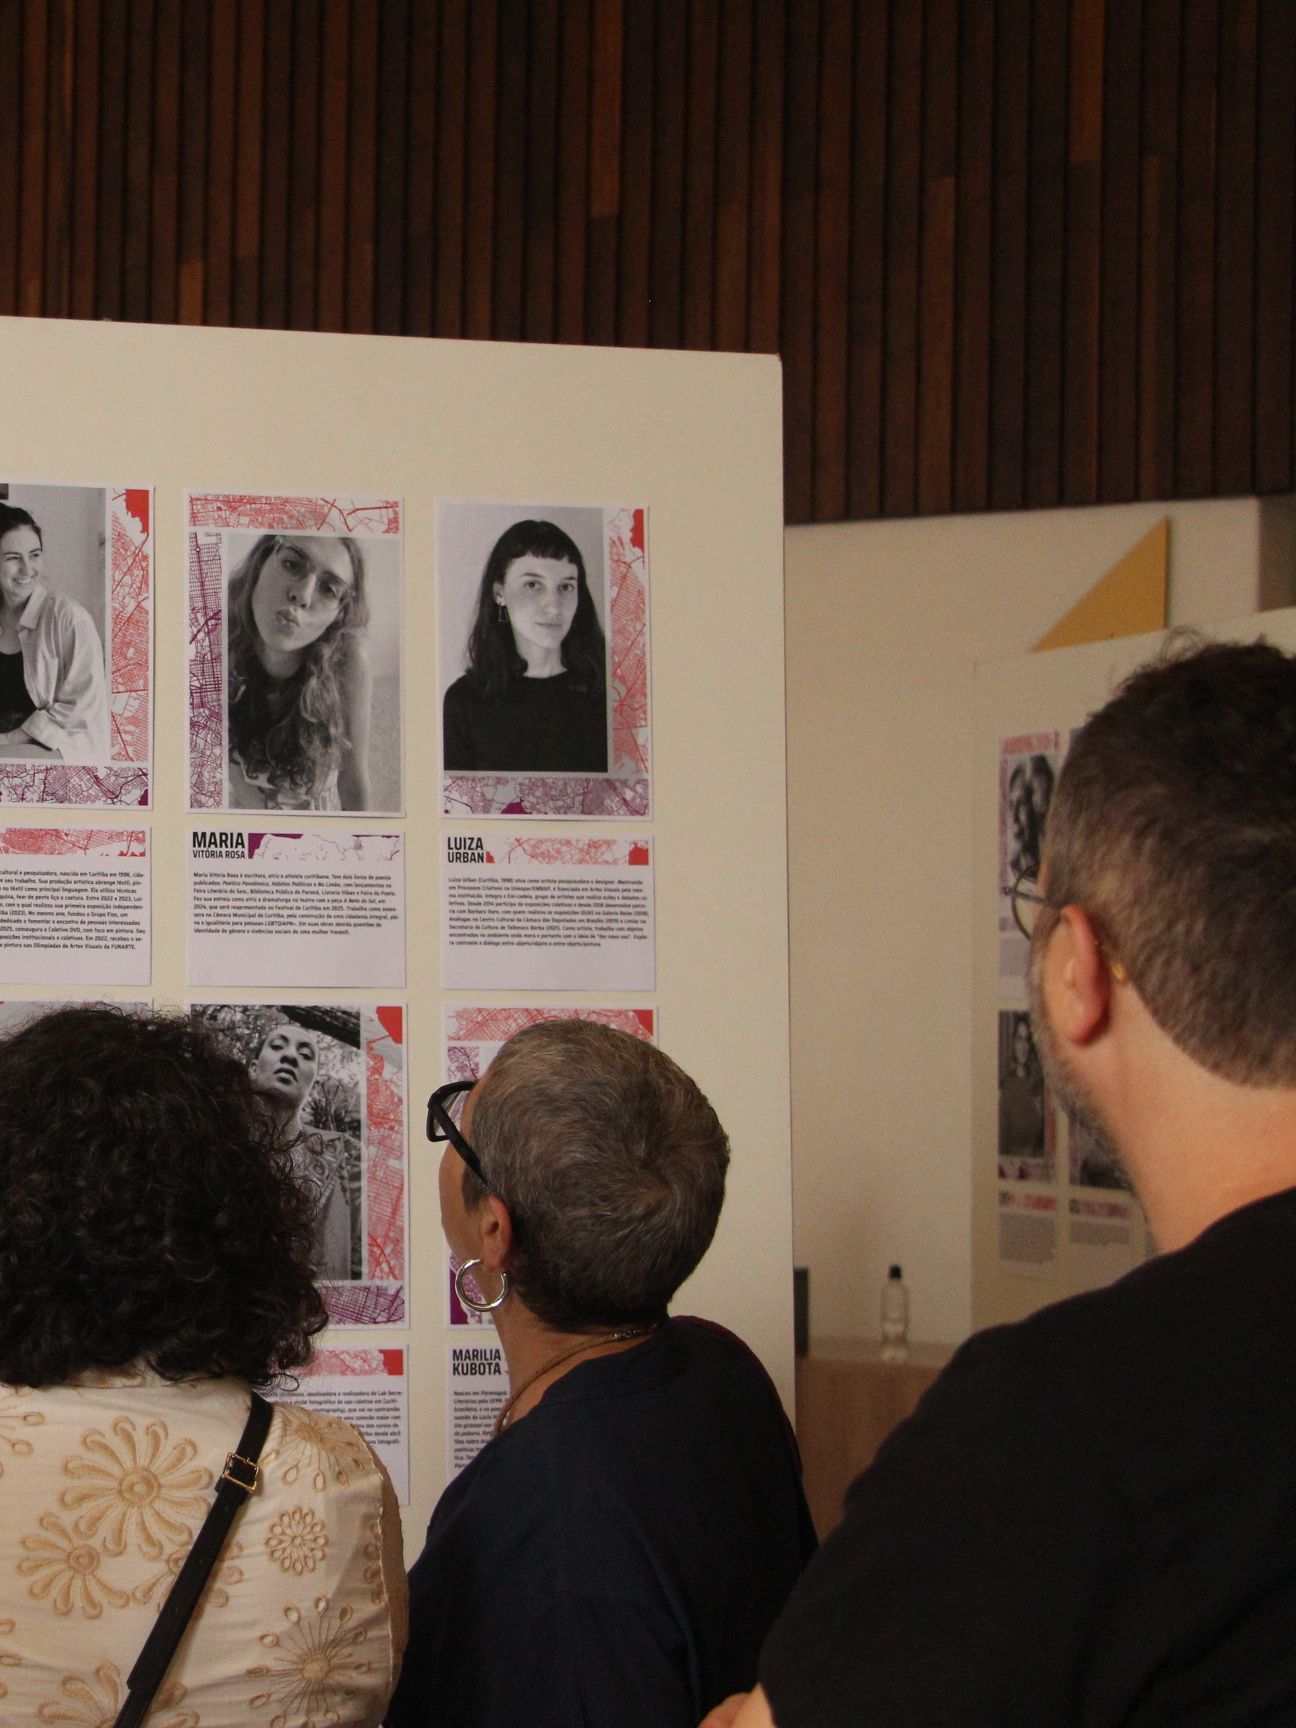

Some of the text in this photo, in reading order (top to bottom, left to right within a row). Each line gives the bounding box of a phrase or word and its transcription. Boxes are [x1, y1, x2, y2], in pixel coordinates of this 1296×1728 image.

[192, 832, 245, 849] MARIA
[448, 837, 483, 851] LUIZA
[192, 848, 245, 859] VITÓRIA ROSA
[448, 851, 484, 863] URBAN
[453, 1349, 501, 1362] MARILIA
[453, 1363, 501, 1375] KUBOTA
